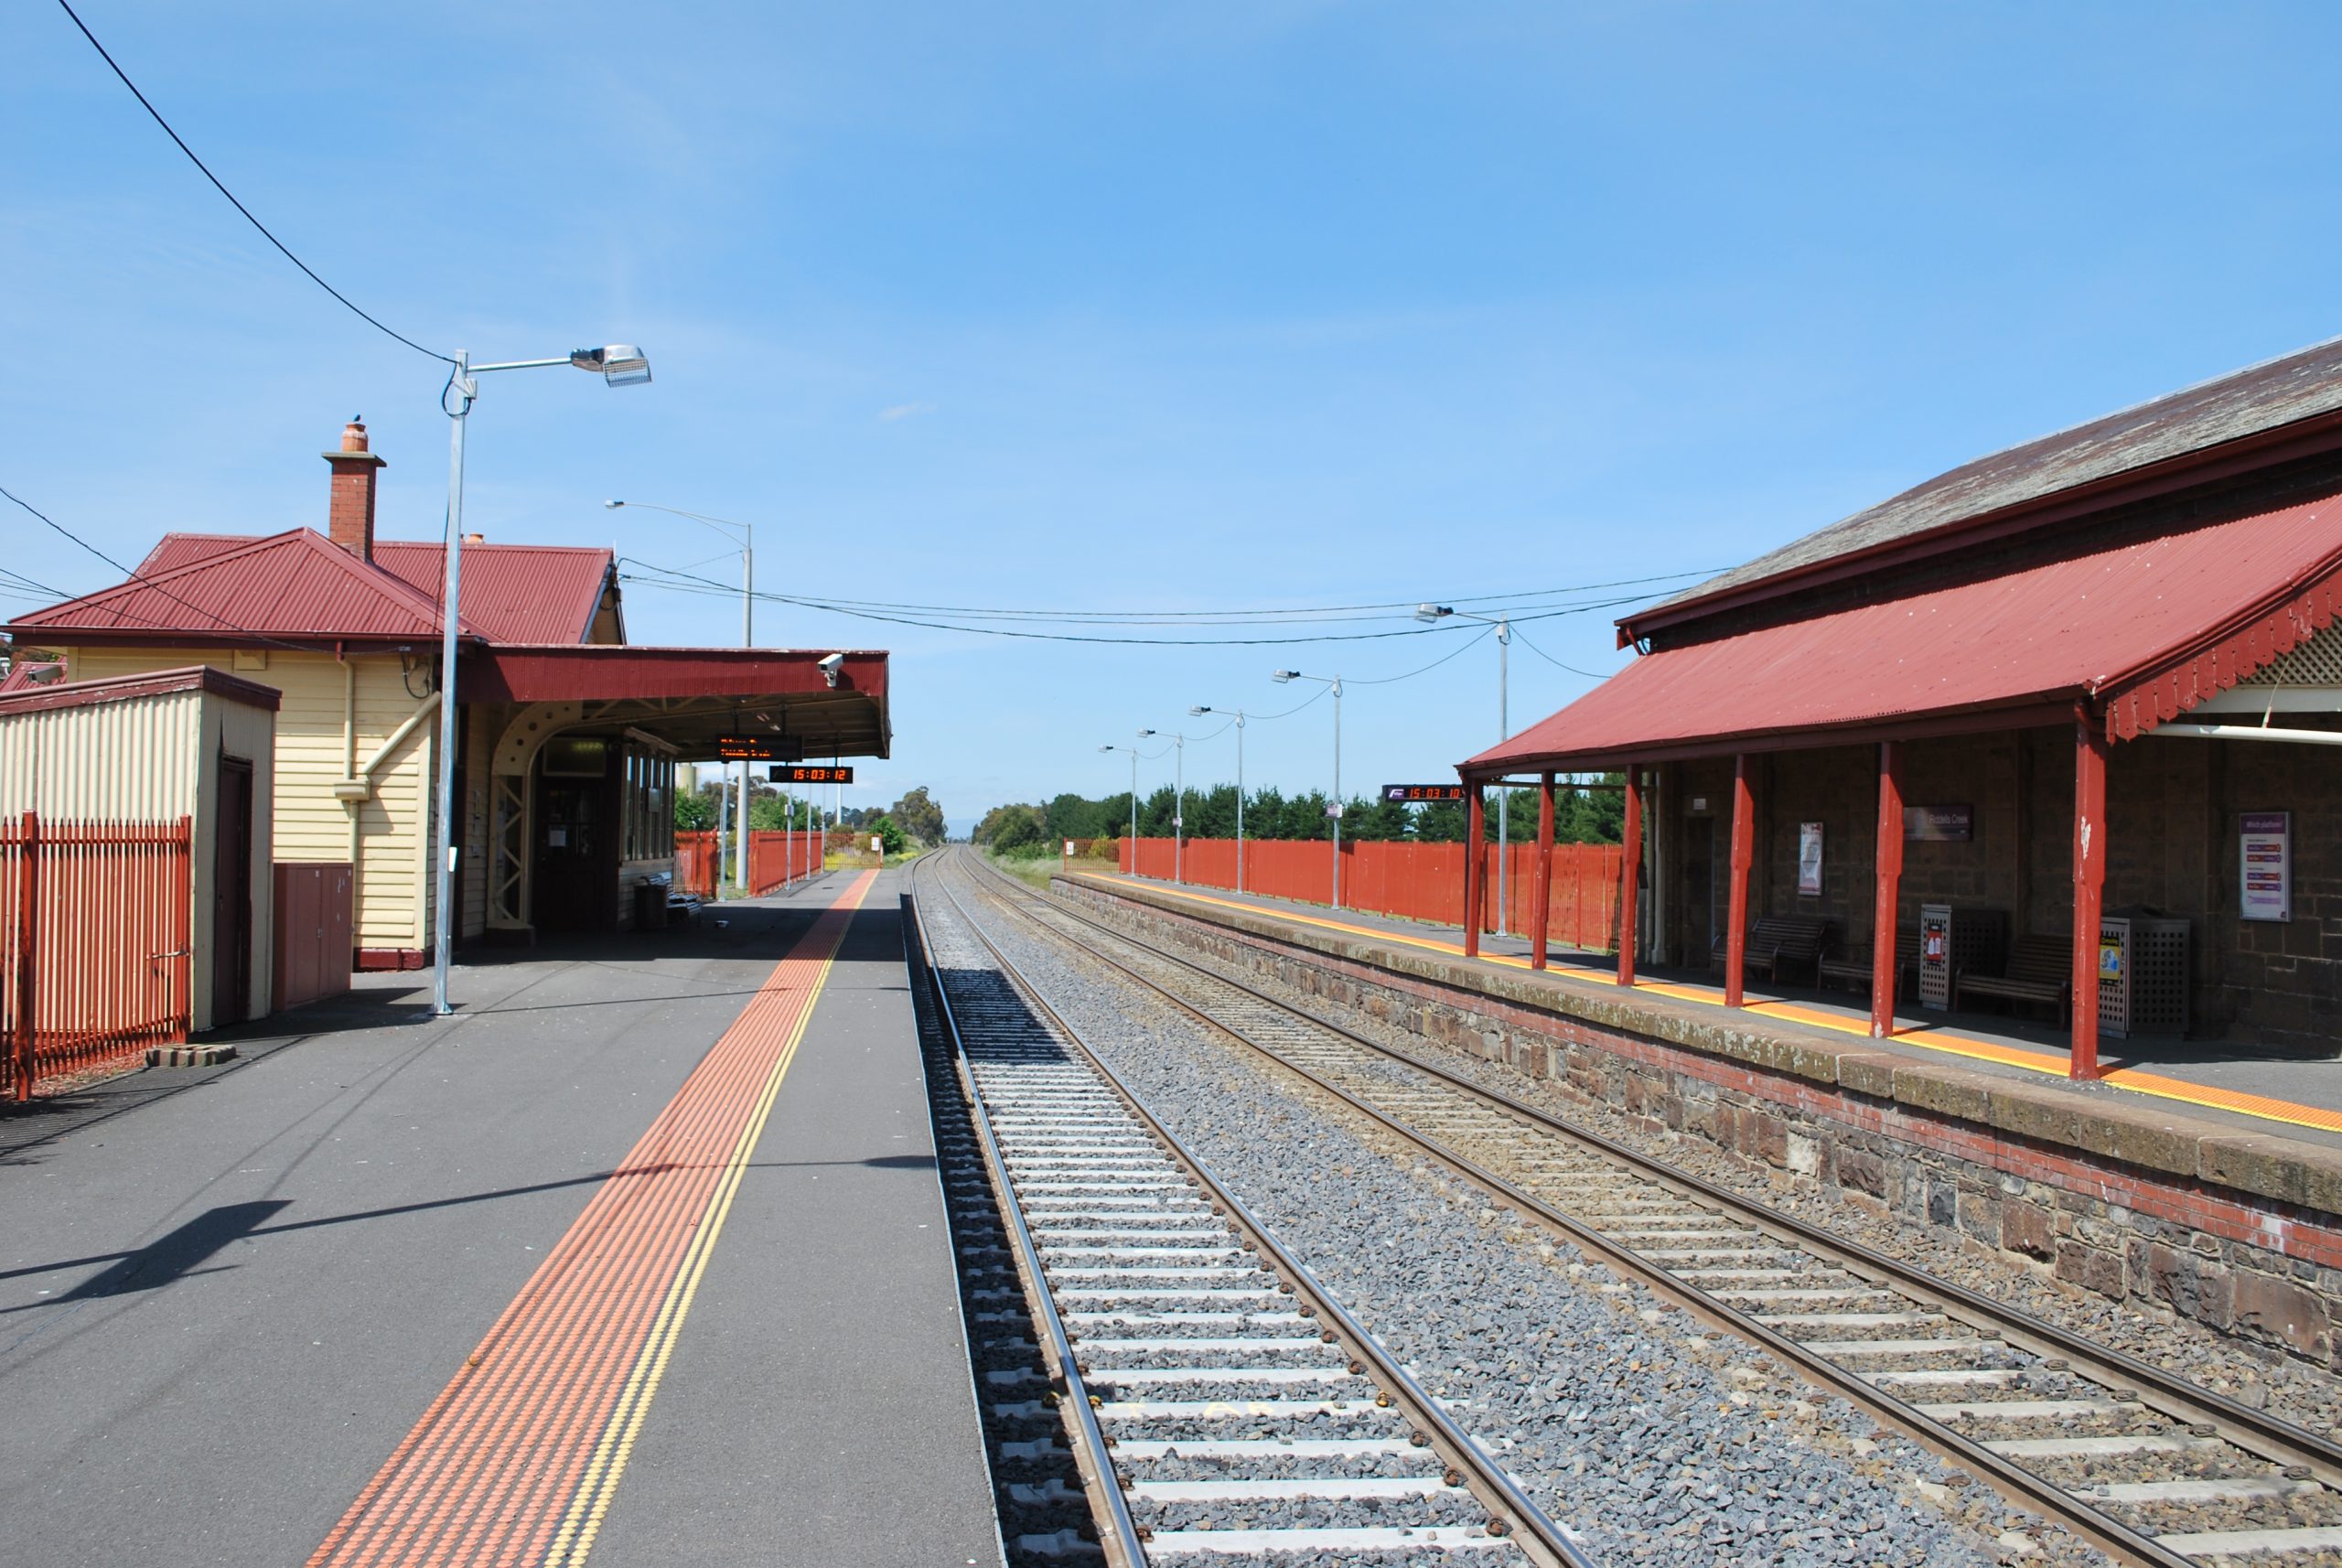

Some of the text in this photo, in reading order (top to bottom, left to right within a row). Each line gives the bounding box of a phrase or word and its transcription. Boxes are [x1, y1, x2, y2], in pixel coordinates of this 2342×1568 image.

[793, 769, 846, 780] 15:03:12
[1409, 788, 1460, 799] 15:03:10
[1951, 813, 1969, 823] Creek
